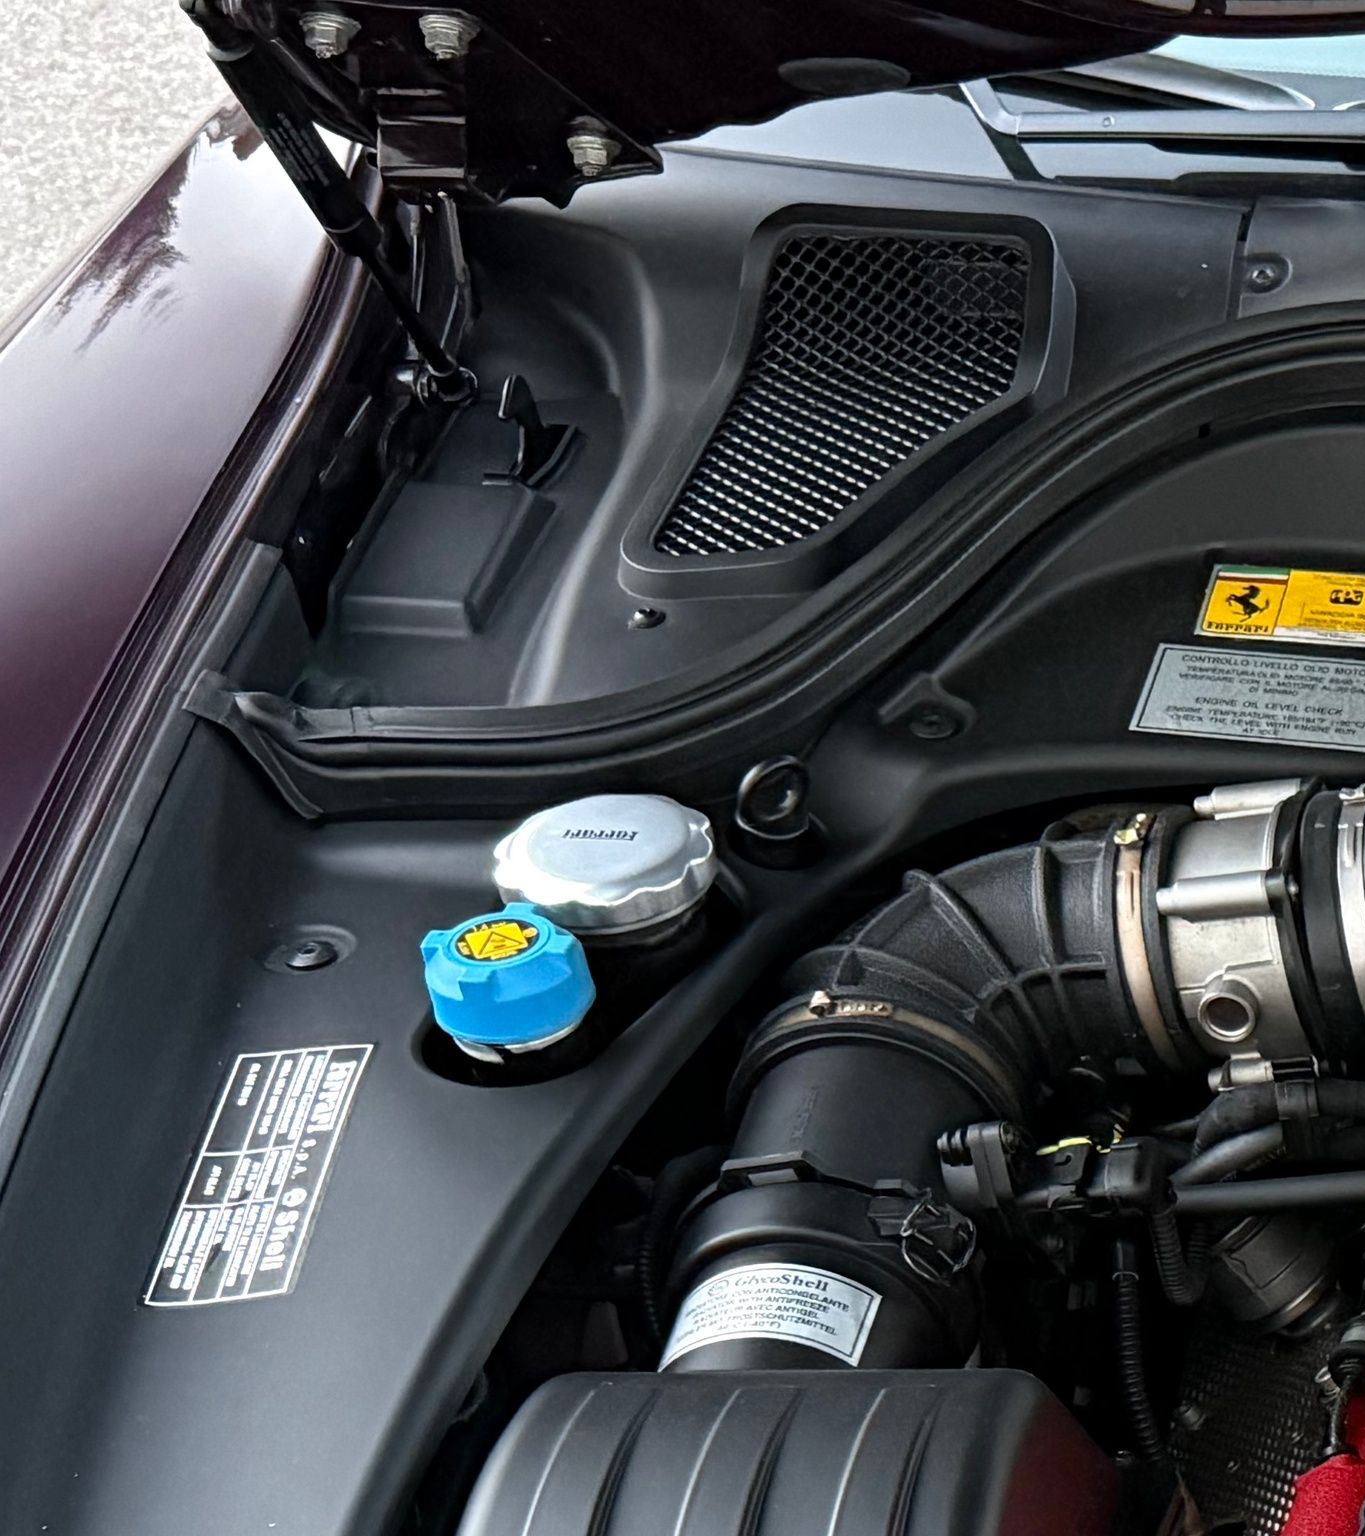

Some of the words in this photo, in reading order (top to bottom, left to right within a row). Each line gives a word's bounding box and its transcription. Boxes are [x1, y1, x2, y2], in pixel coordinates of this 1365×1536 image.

[1182, 654, 1250, 667] CONTROLLO
[1253, 661, 1299, 671] LIVELLO
[1303, 664, 1330, 674] OLIO
[1195, 697, 1238, 707] ENGINE
[1265, 703, 1299, 712] LEVEL
[1304, 706, 1343, 716] CHECK
[306, 1060, 357, 1134] Ferrari
[259, 1210, 300, 1271] Shell
